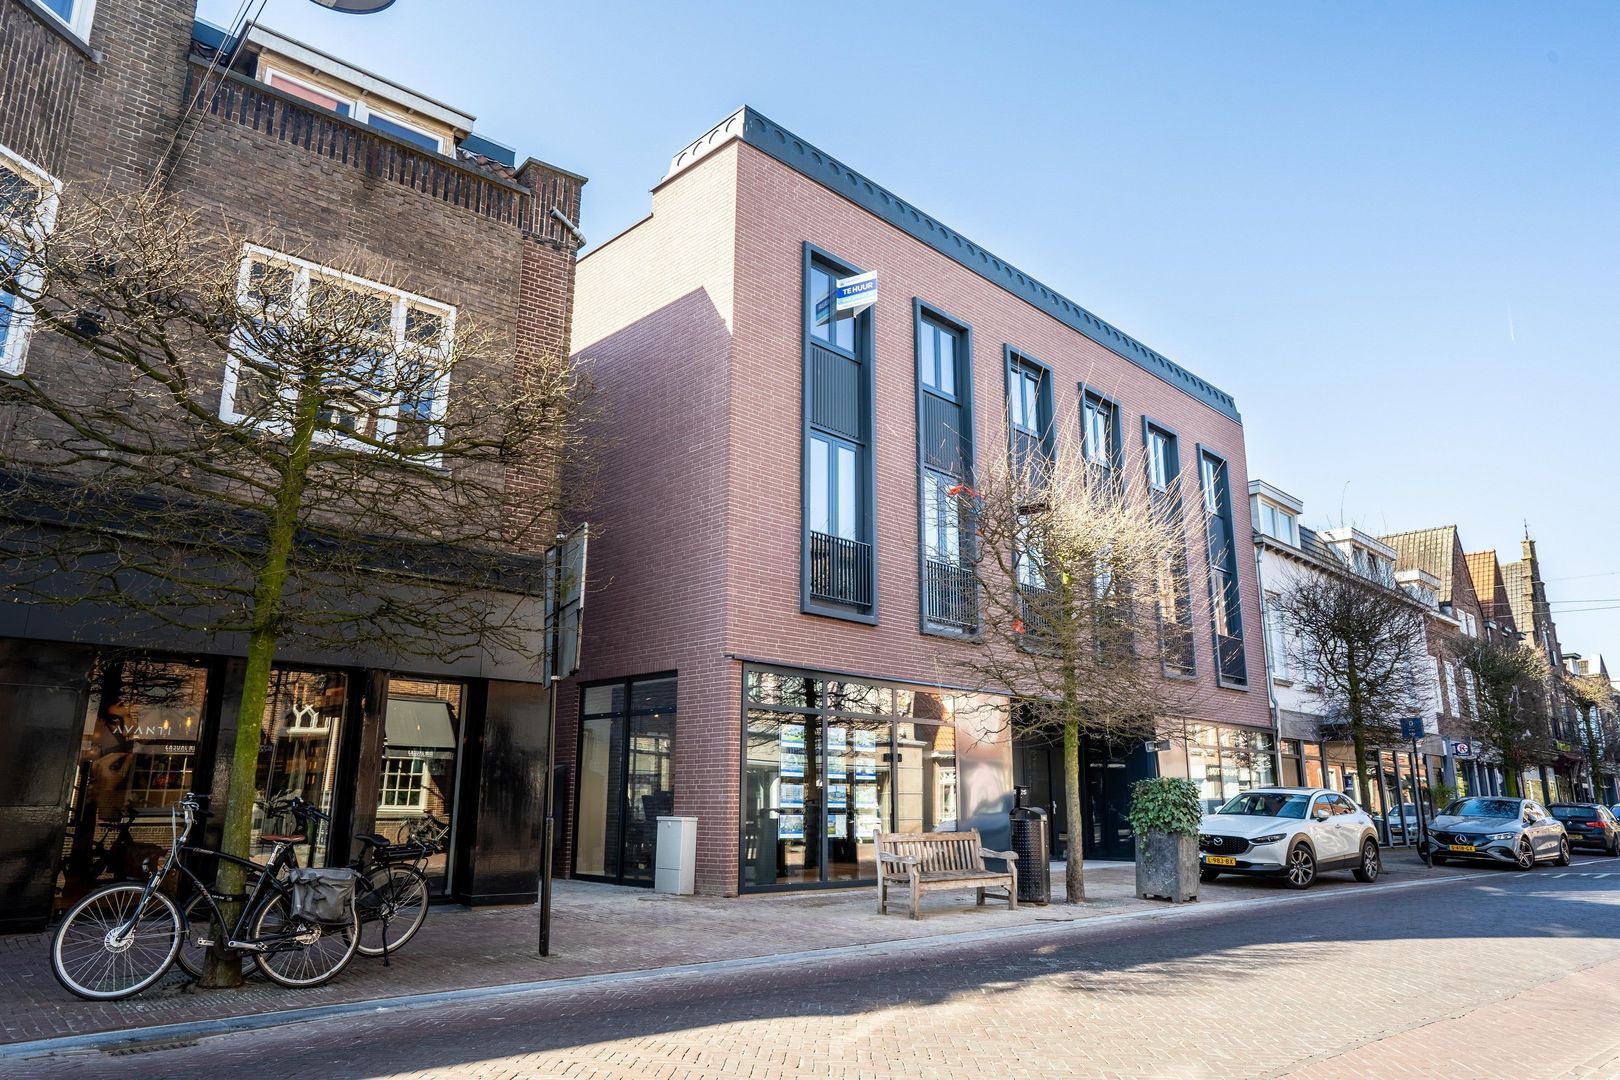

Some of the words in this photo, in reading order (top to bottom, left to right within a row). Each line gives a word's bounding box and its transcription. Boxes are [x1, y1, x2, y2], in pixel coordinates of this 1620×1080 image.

[842, 287, 851, 295] TE
[852, 282, 873, 292] HUUR
[112, 725, 171, 736] AVANTI
